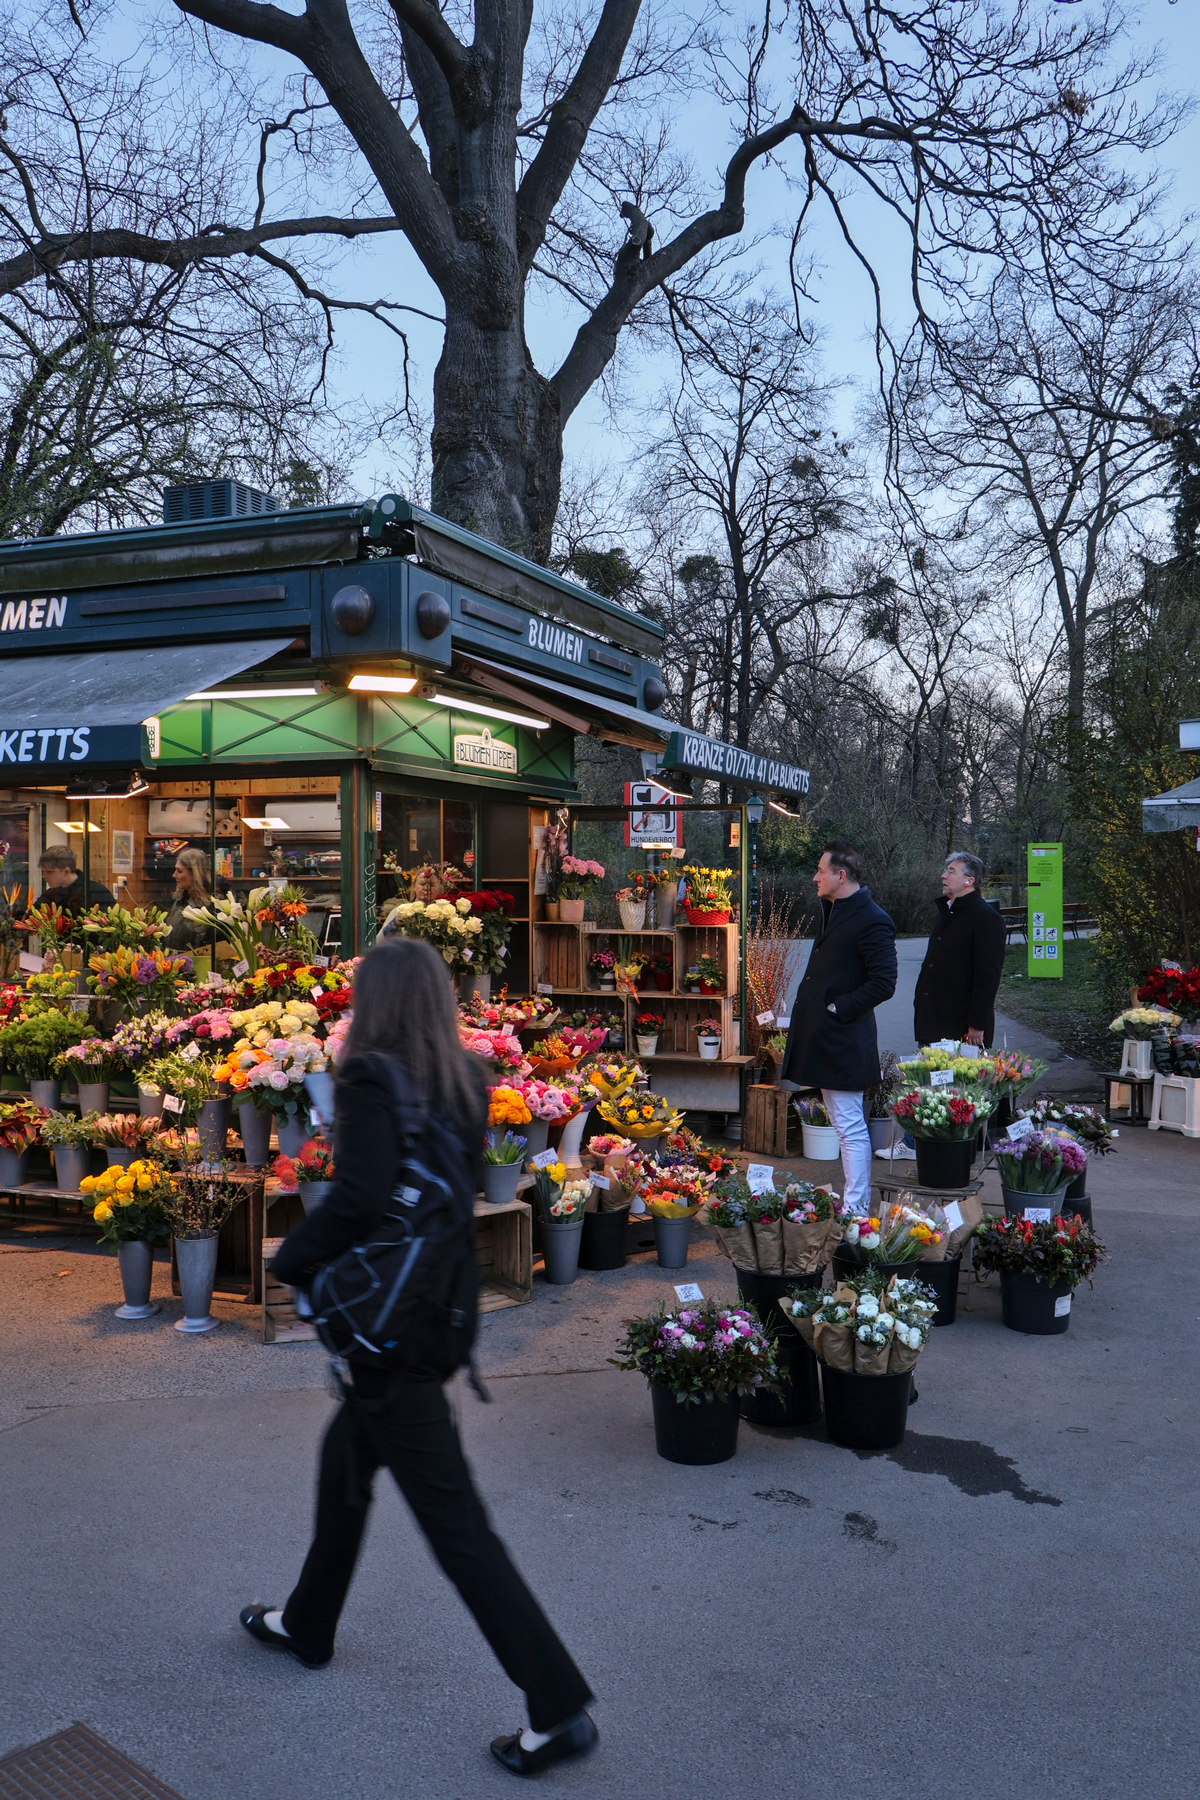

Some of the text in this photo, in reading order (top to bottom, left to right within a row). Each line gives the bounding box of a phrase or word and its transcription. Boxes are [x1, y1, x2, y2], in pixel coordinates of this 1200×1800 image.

[0, 596, 68, 631] MEN
[528, 618, 583, 663] BLUMEN
[0, 727, 91, 762] KETTS
[683, 735, 810, 793] KRÄNZE 01/714 41 04 BUKETTS
